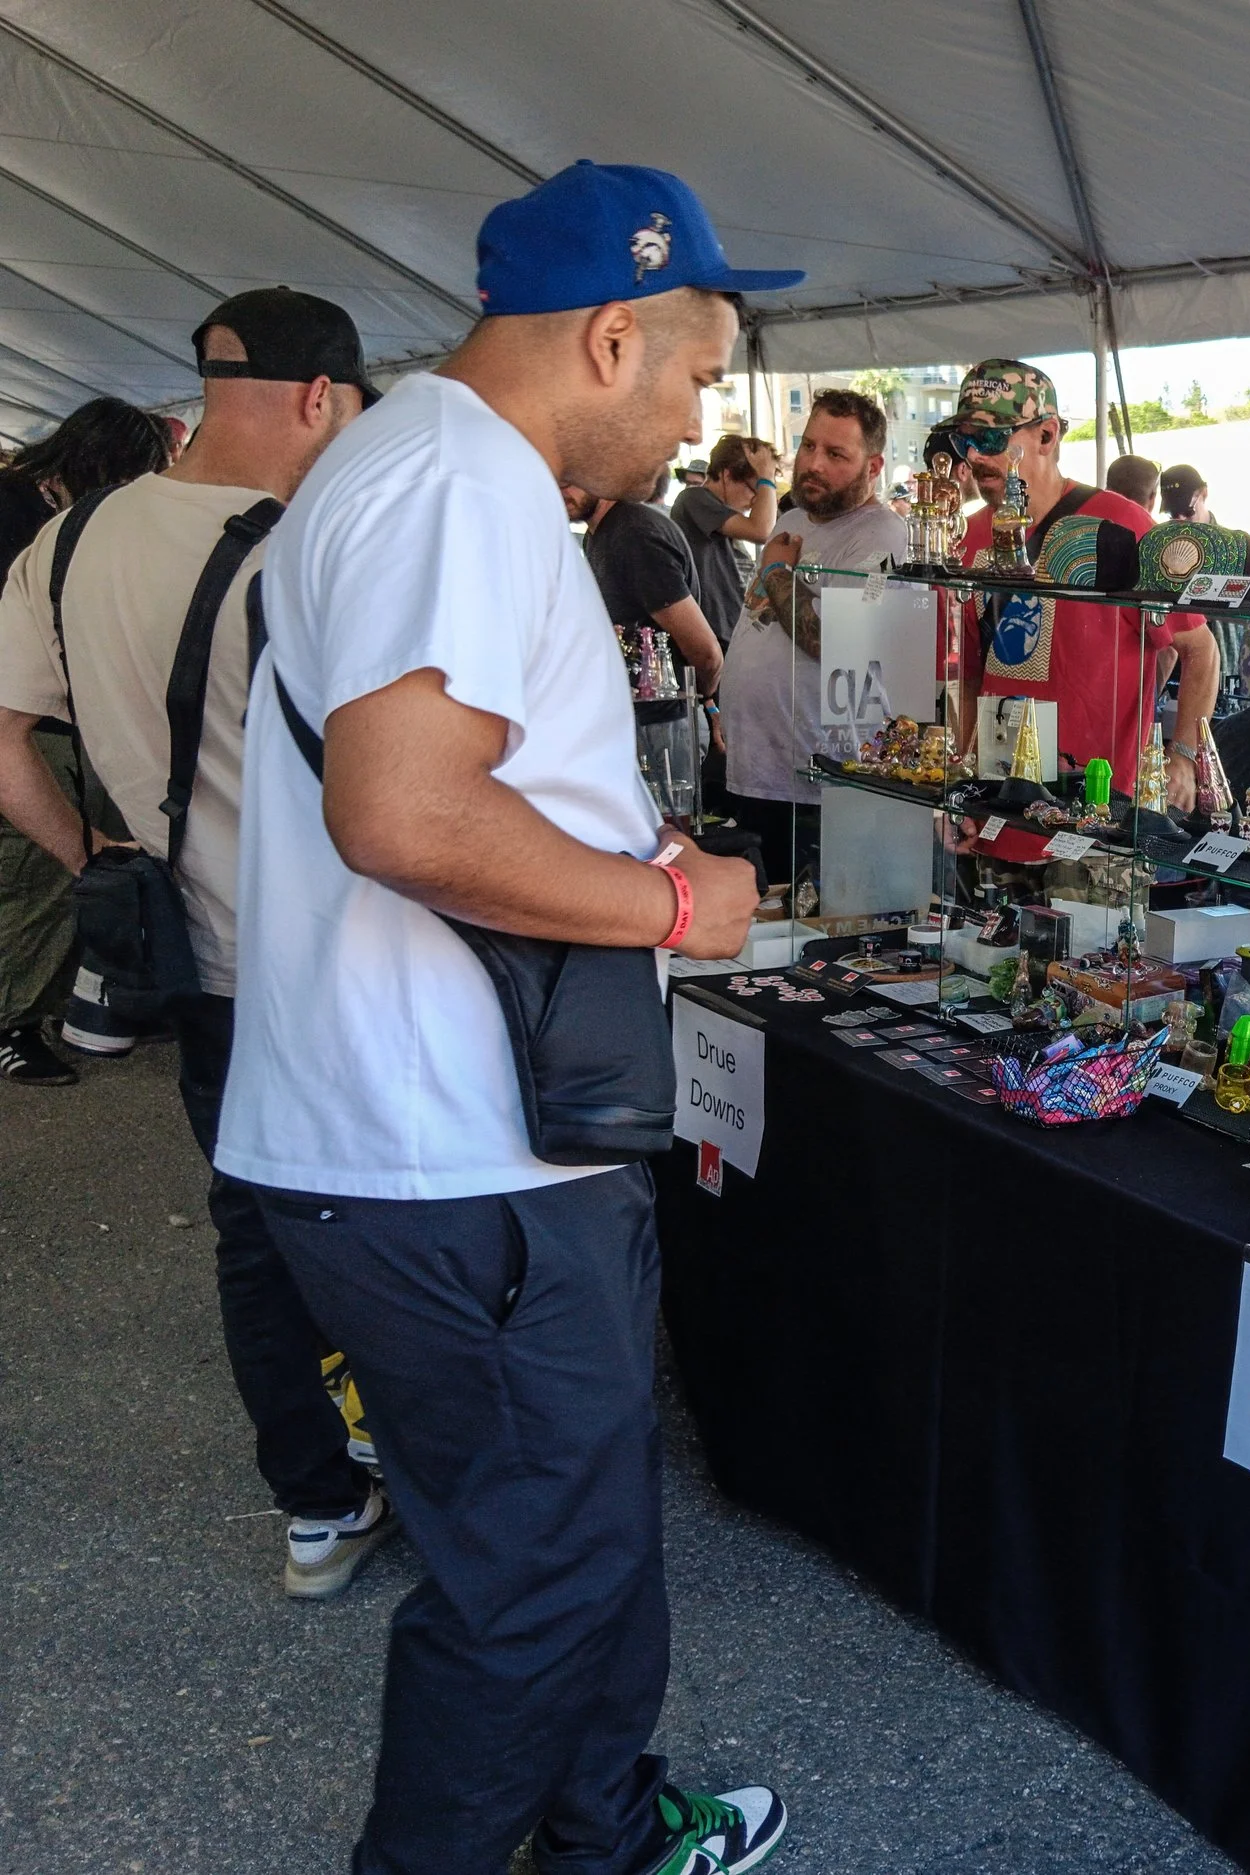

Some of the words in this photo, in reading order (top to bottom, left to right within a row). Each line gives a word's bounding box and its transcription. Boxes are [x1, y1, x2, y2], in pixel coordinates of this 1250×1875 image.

[1205, 846, 1238, 859] PUFFCO
[696, 1031, 737, 1075] Drue
[1161, 1072, 1196, 1088] PUFFCO
[1152, 1082, 1179, 1095] PROXY
[690, 1078, 745, 1131] Downs
